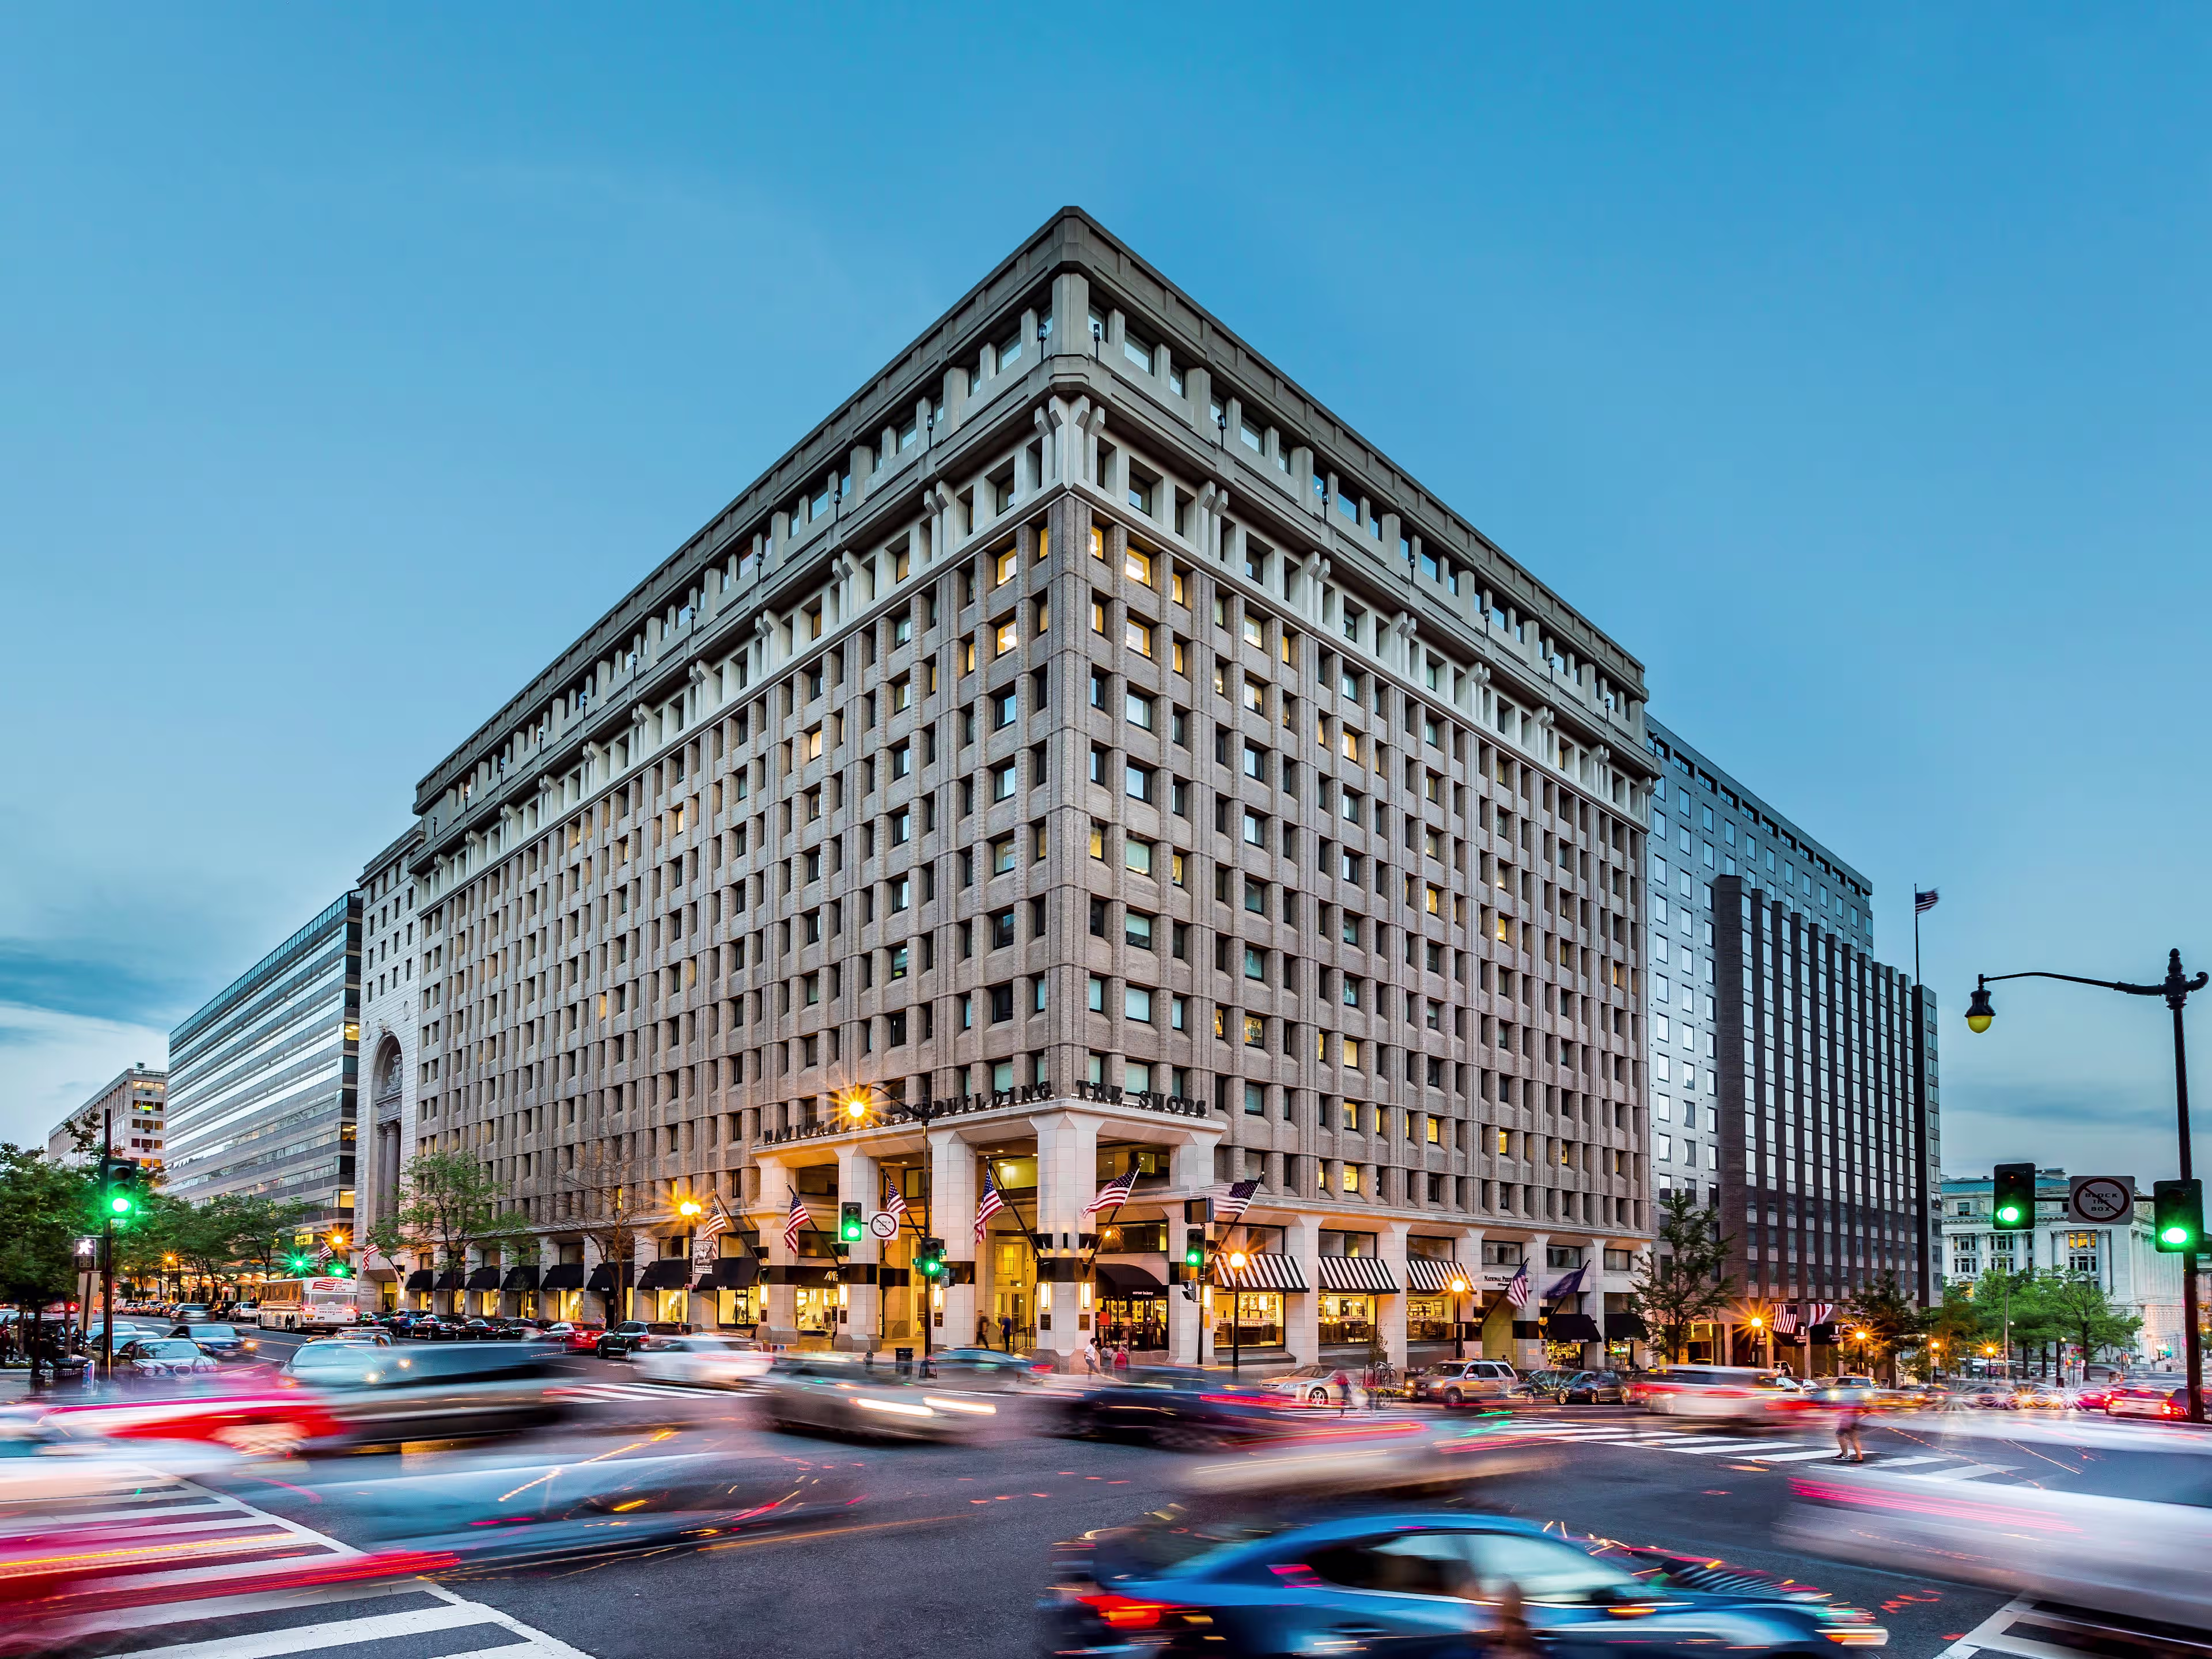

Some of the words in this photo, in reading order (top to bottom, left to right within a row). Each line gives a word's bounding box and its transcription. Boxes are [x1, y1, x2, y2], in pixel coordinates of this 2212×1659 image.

[764, 1115, 850, 1144] NATIONA
[933, 1081, 1052, 1116] BUILDING
[1076, 1080, 1123, 1103] THE
[1139, 1090, 1206, 1116] SHOPS
